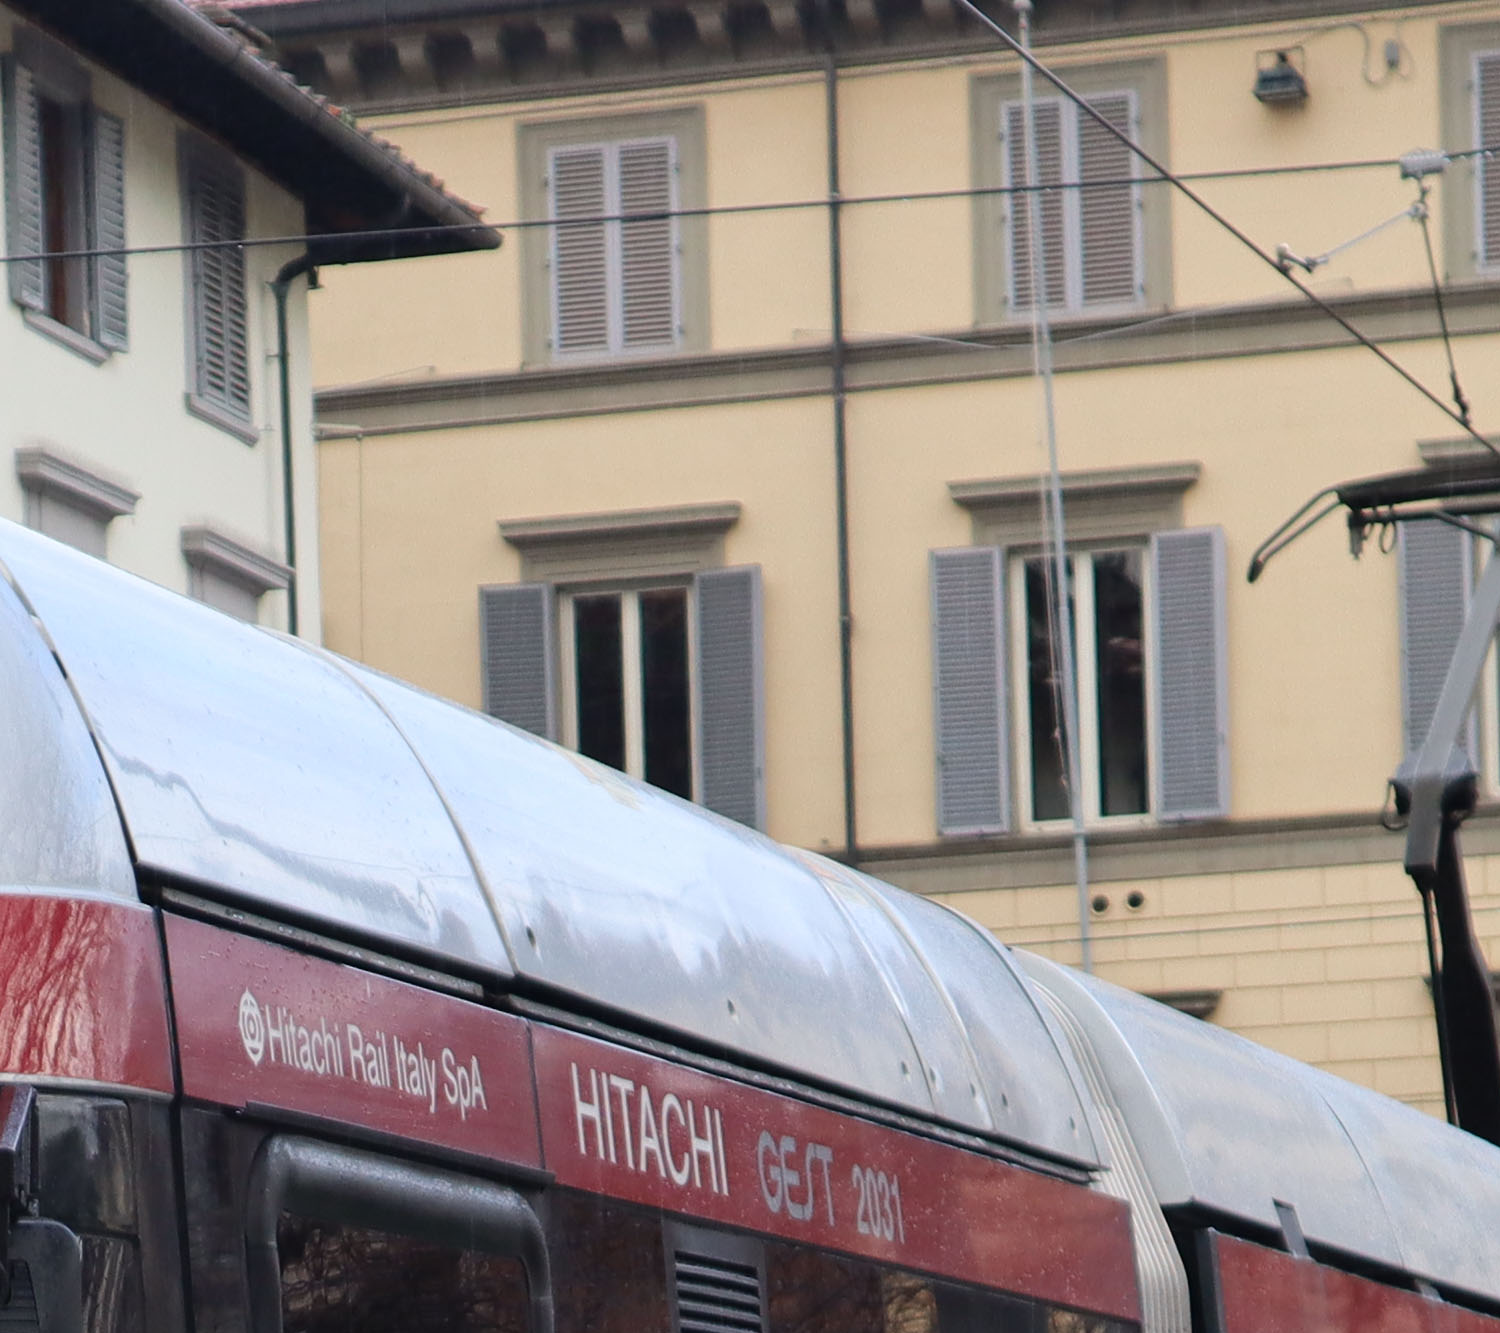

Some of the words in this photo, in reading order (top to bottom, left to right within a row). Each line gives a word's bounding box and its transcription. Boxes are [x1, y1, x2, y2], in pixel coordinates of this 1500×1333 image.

[264, 1003, 345, 1078] Hitachi
[346, 1023, 391, 1088] Rail
[393, 1034, 436, 1114] Italy
[441, 1047, 488, 1122] SpA
[570, 1061, 729, 1196] HITACHI
[757, 1129, 836, 1227] GEST
[851, 1162, 905, 1245] 2031
